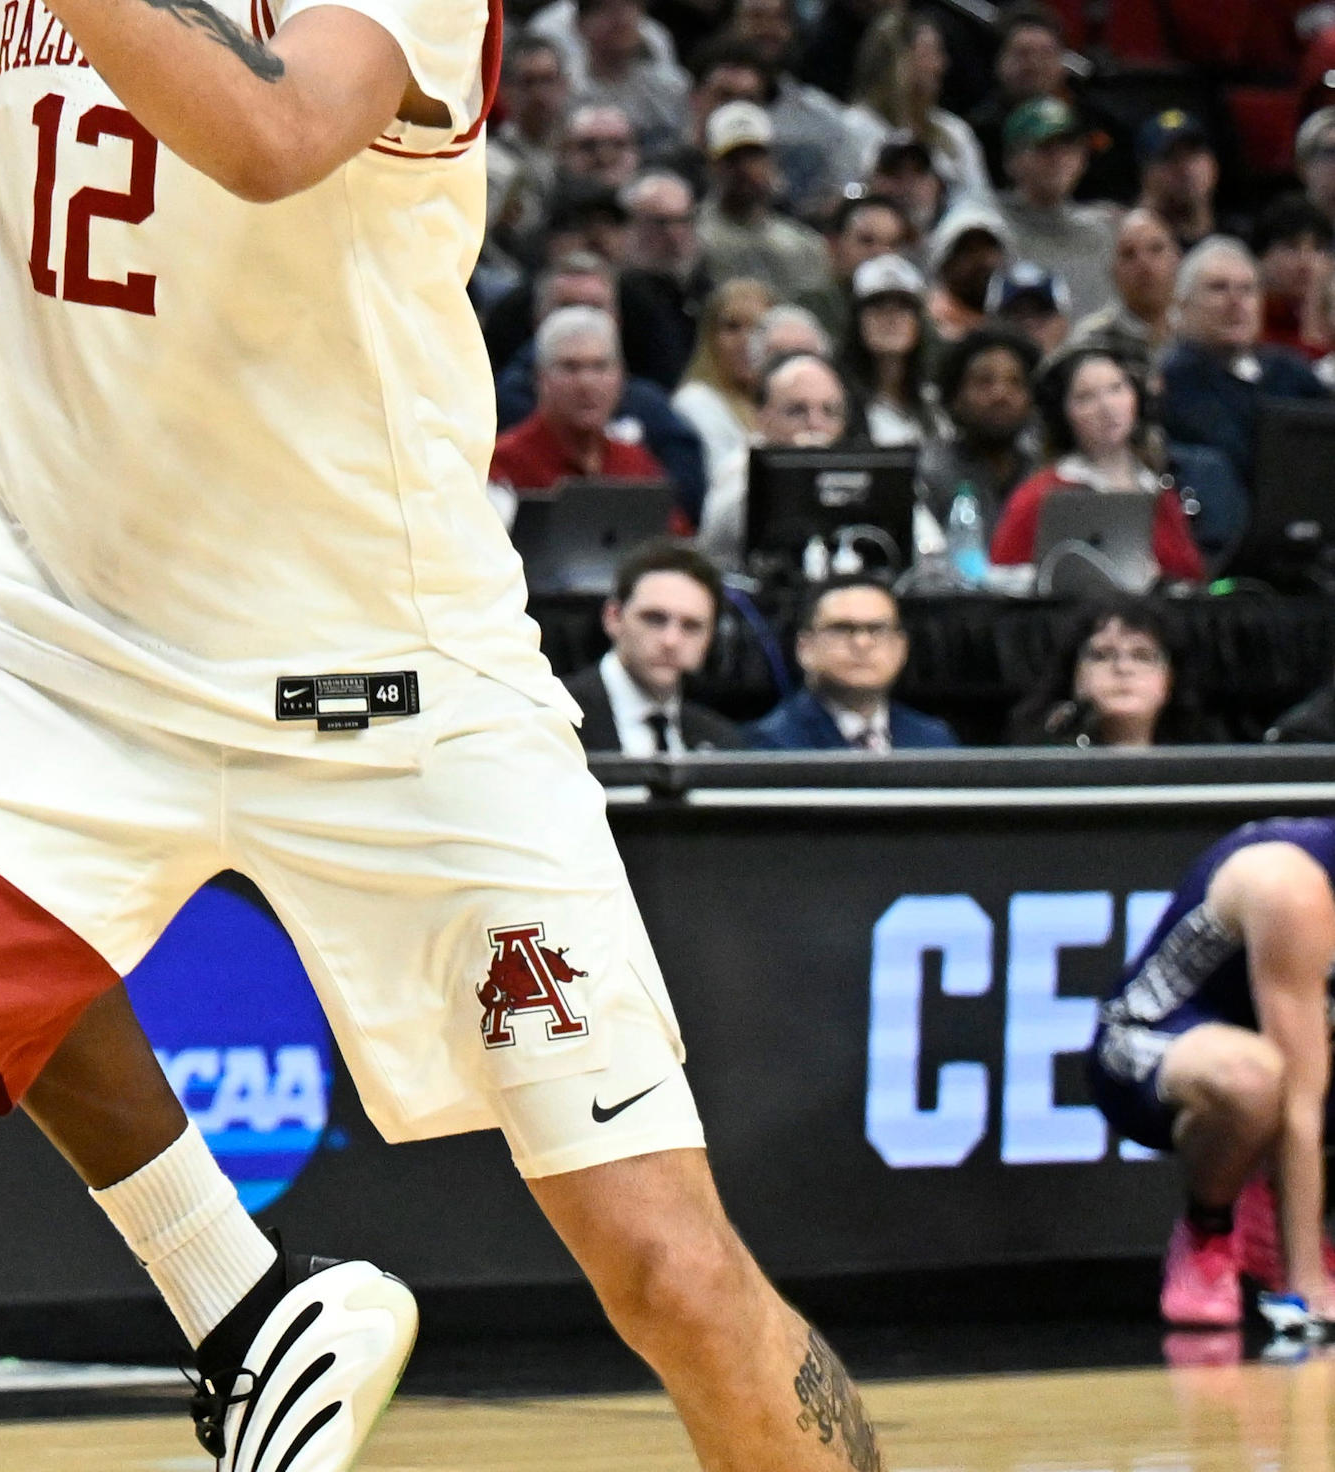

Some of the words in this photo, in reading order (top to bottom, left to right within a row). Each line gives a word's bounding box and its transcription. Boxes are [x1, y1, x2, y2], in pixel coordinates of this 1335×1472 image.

[28, 92, 157, 317] 12
[375, 684, 400, 703] 48
[152, 1043, 327, 1134] CAA
